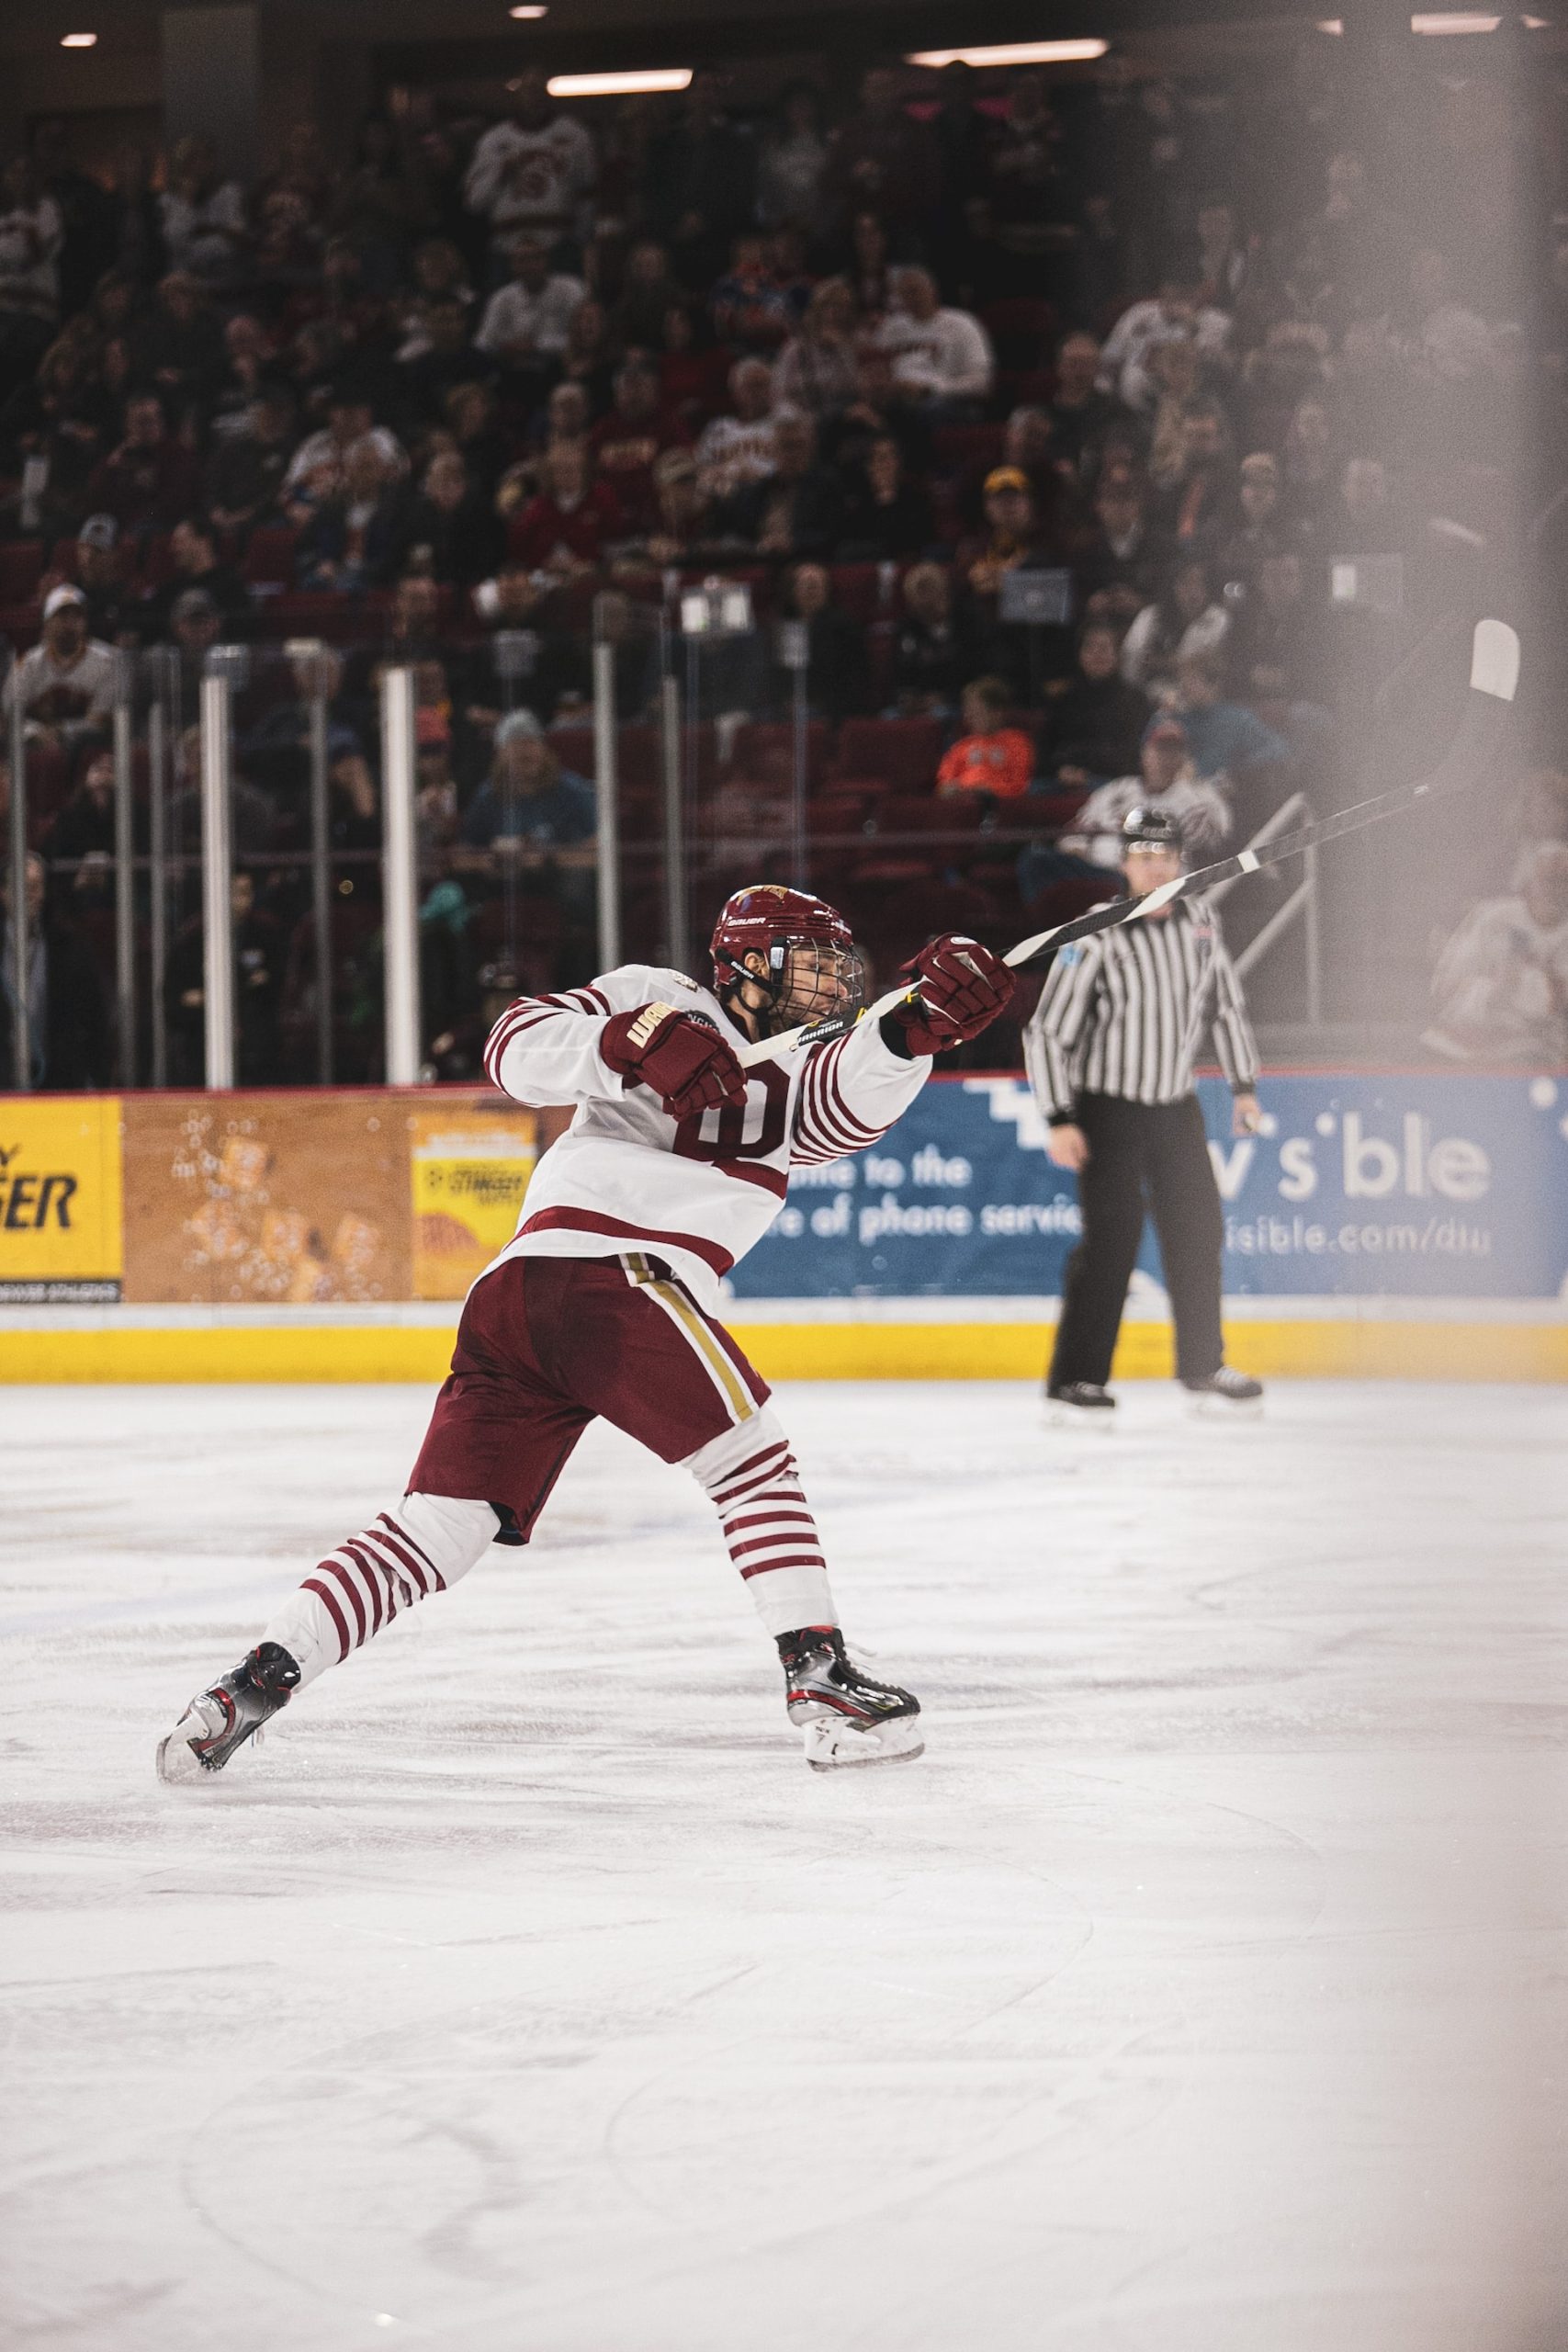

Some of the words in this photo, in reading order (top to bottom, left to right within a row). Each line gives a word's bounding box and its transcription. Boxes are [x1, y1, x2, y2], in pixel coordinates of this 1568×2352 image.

[728, 917, 766, 927] BAUER
[731, 960, 754, 979] BAUER
[788, 1159, 856, 1190] me
[865, 1152, 906, 1189] to
[913, 1144, 973, 1189] the
[0, 1174, 78, 1228] ER
[811, 1193, 852, 1238] of
[859, 1193, 974, 1247] phone
[981, 1193, 1083, 1237] servic
